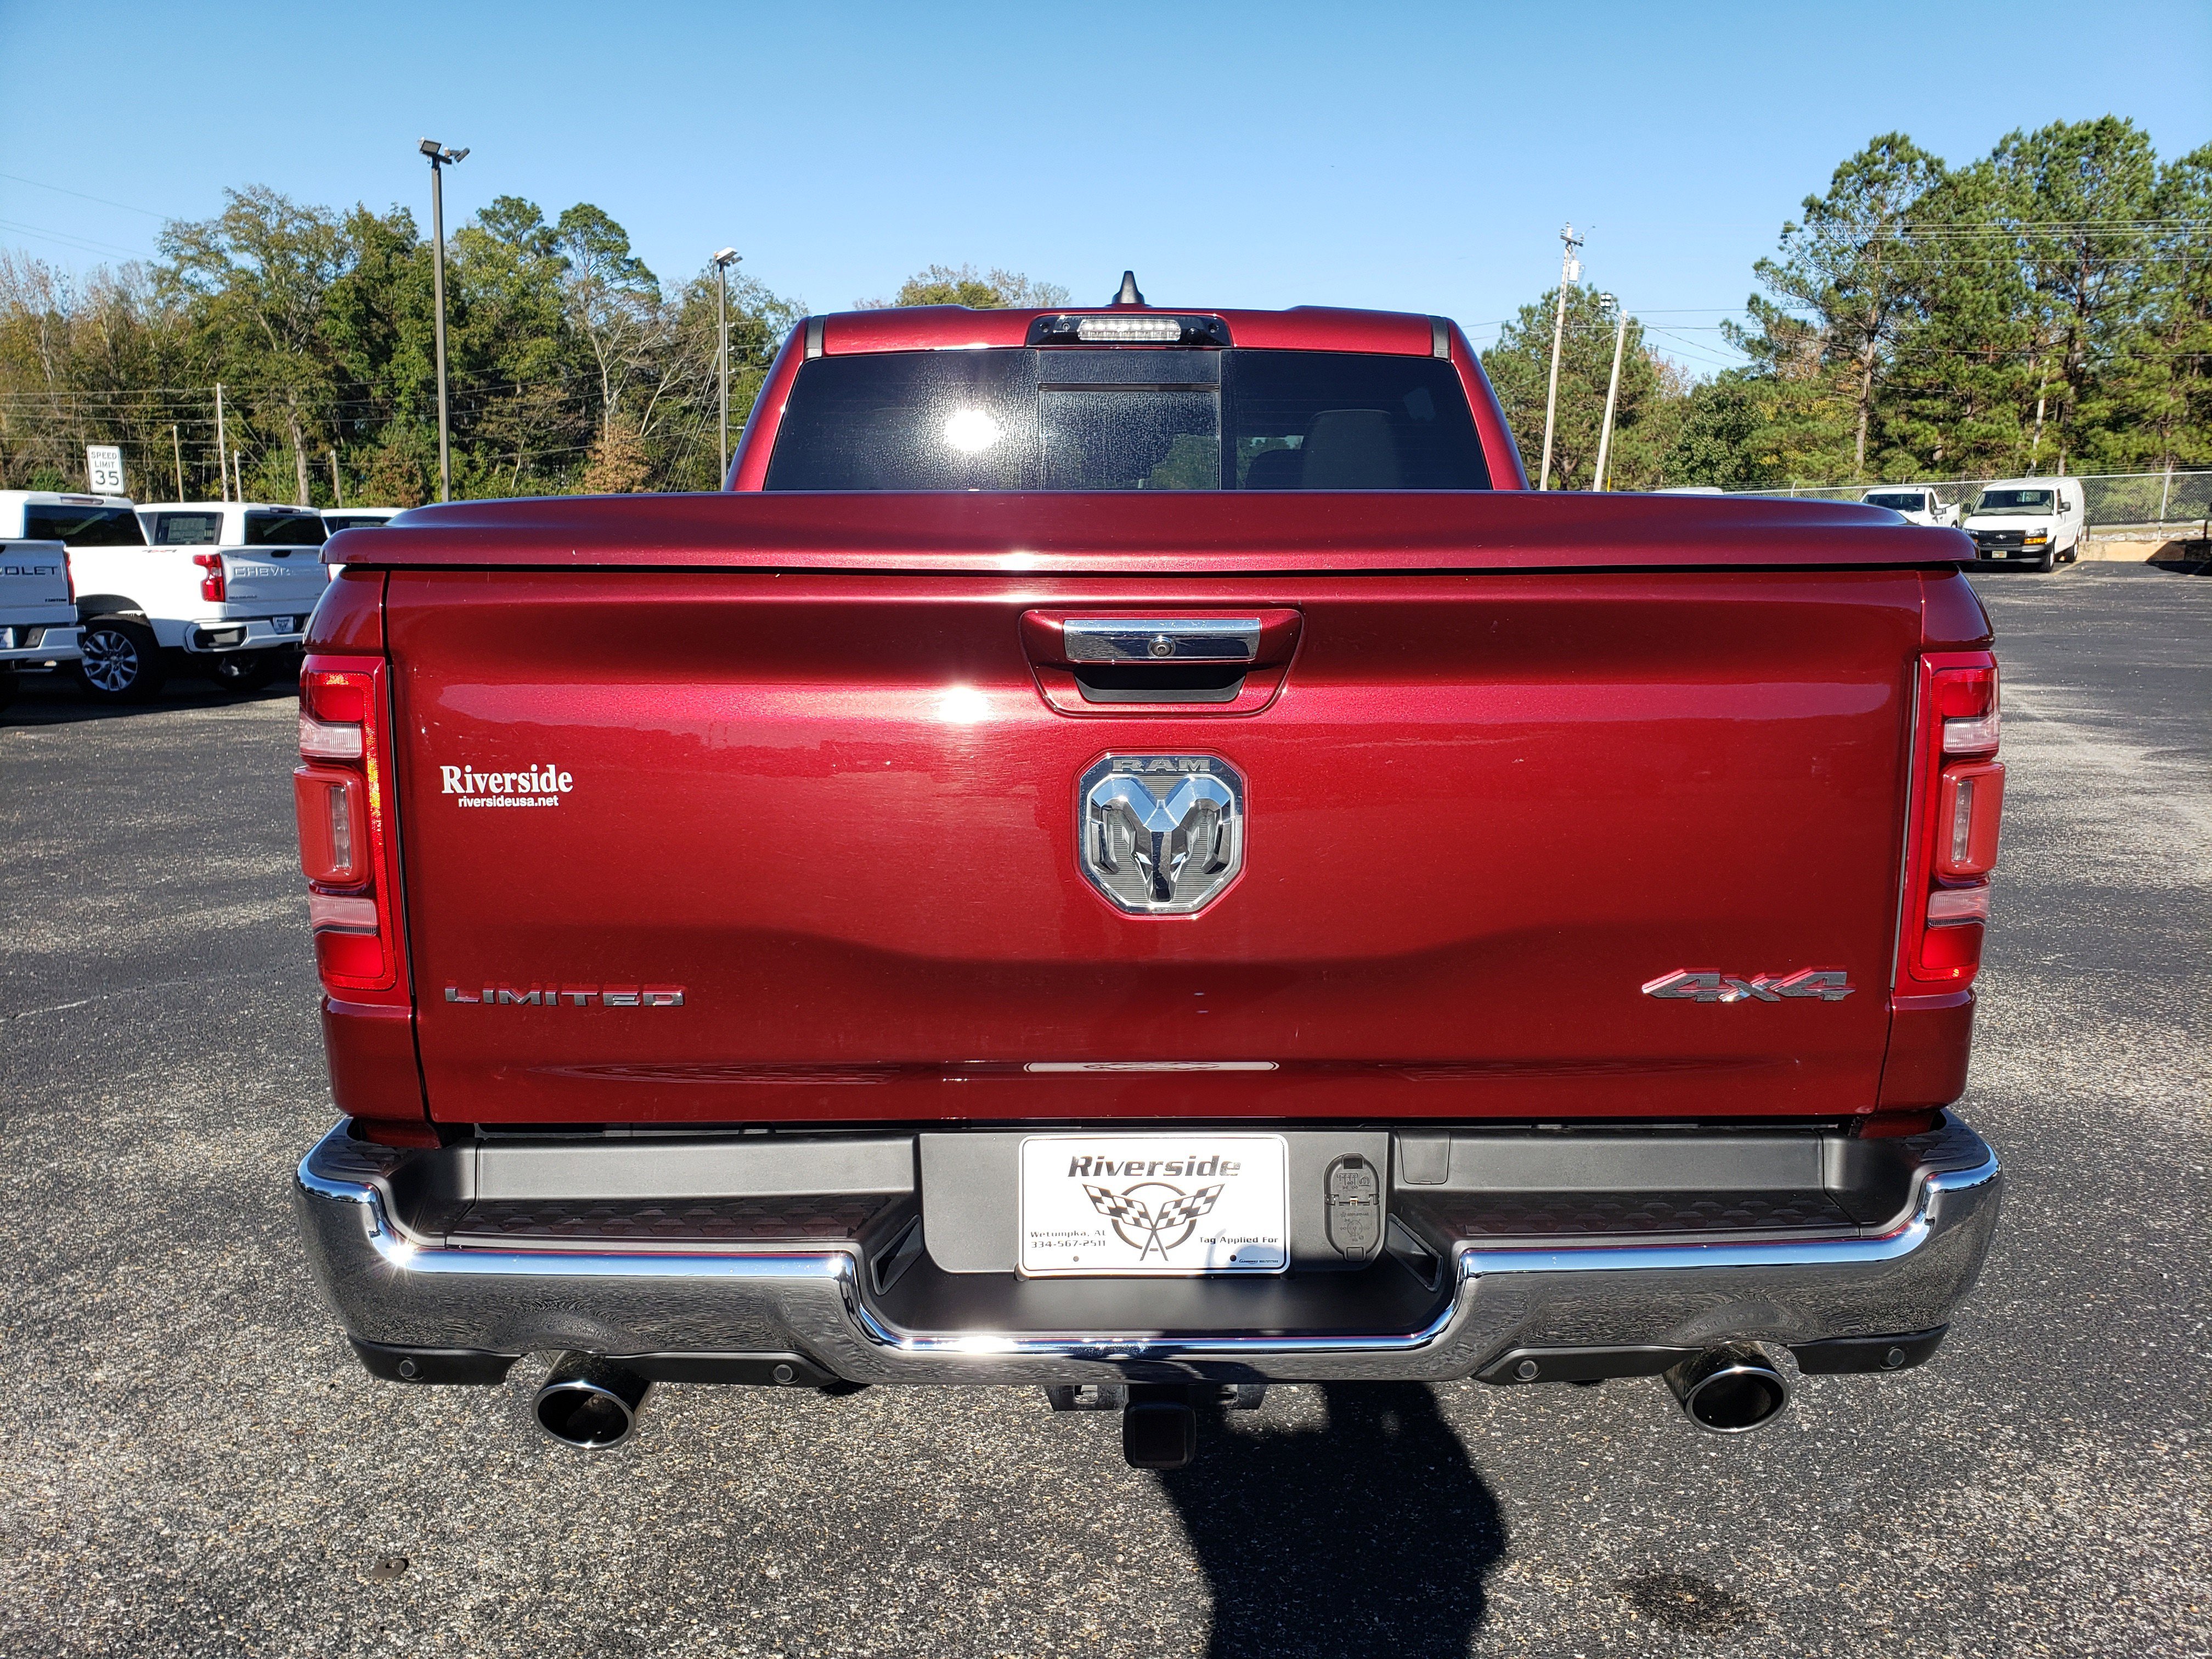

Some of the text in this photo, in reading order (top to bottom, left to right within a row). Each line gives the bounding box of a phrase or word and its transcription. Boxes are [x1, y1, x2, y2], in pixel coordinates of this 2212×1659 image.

[91, 452, 117, 460] SPEED
[95, 470, 119, 486] 35
[0, 566, 58, 575] OLET
[1112, 759, 1211, 771] RAM
[440, 764, 573, 793] Riverside
[458, 795, 559, 807] riversideusa.net
[445, 988, 684, 1006] LIMITED
[1068, 1155, 1241, 1177] Riverside
[1031, 1240, 1105, 1248] 334-567-2511
